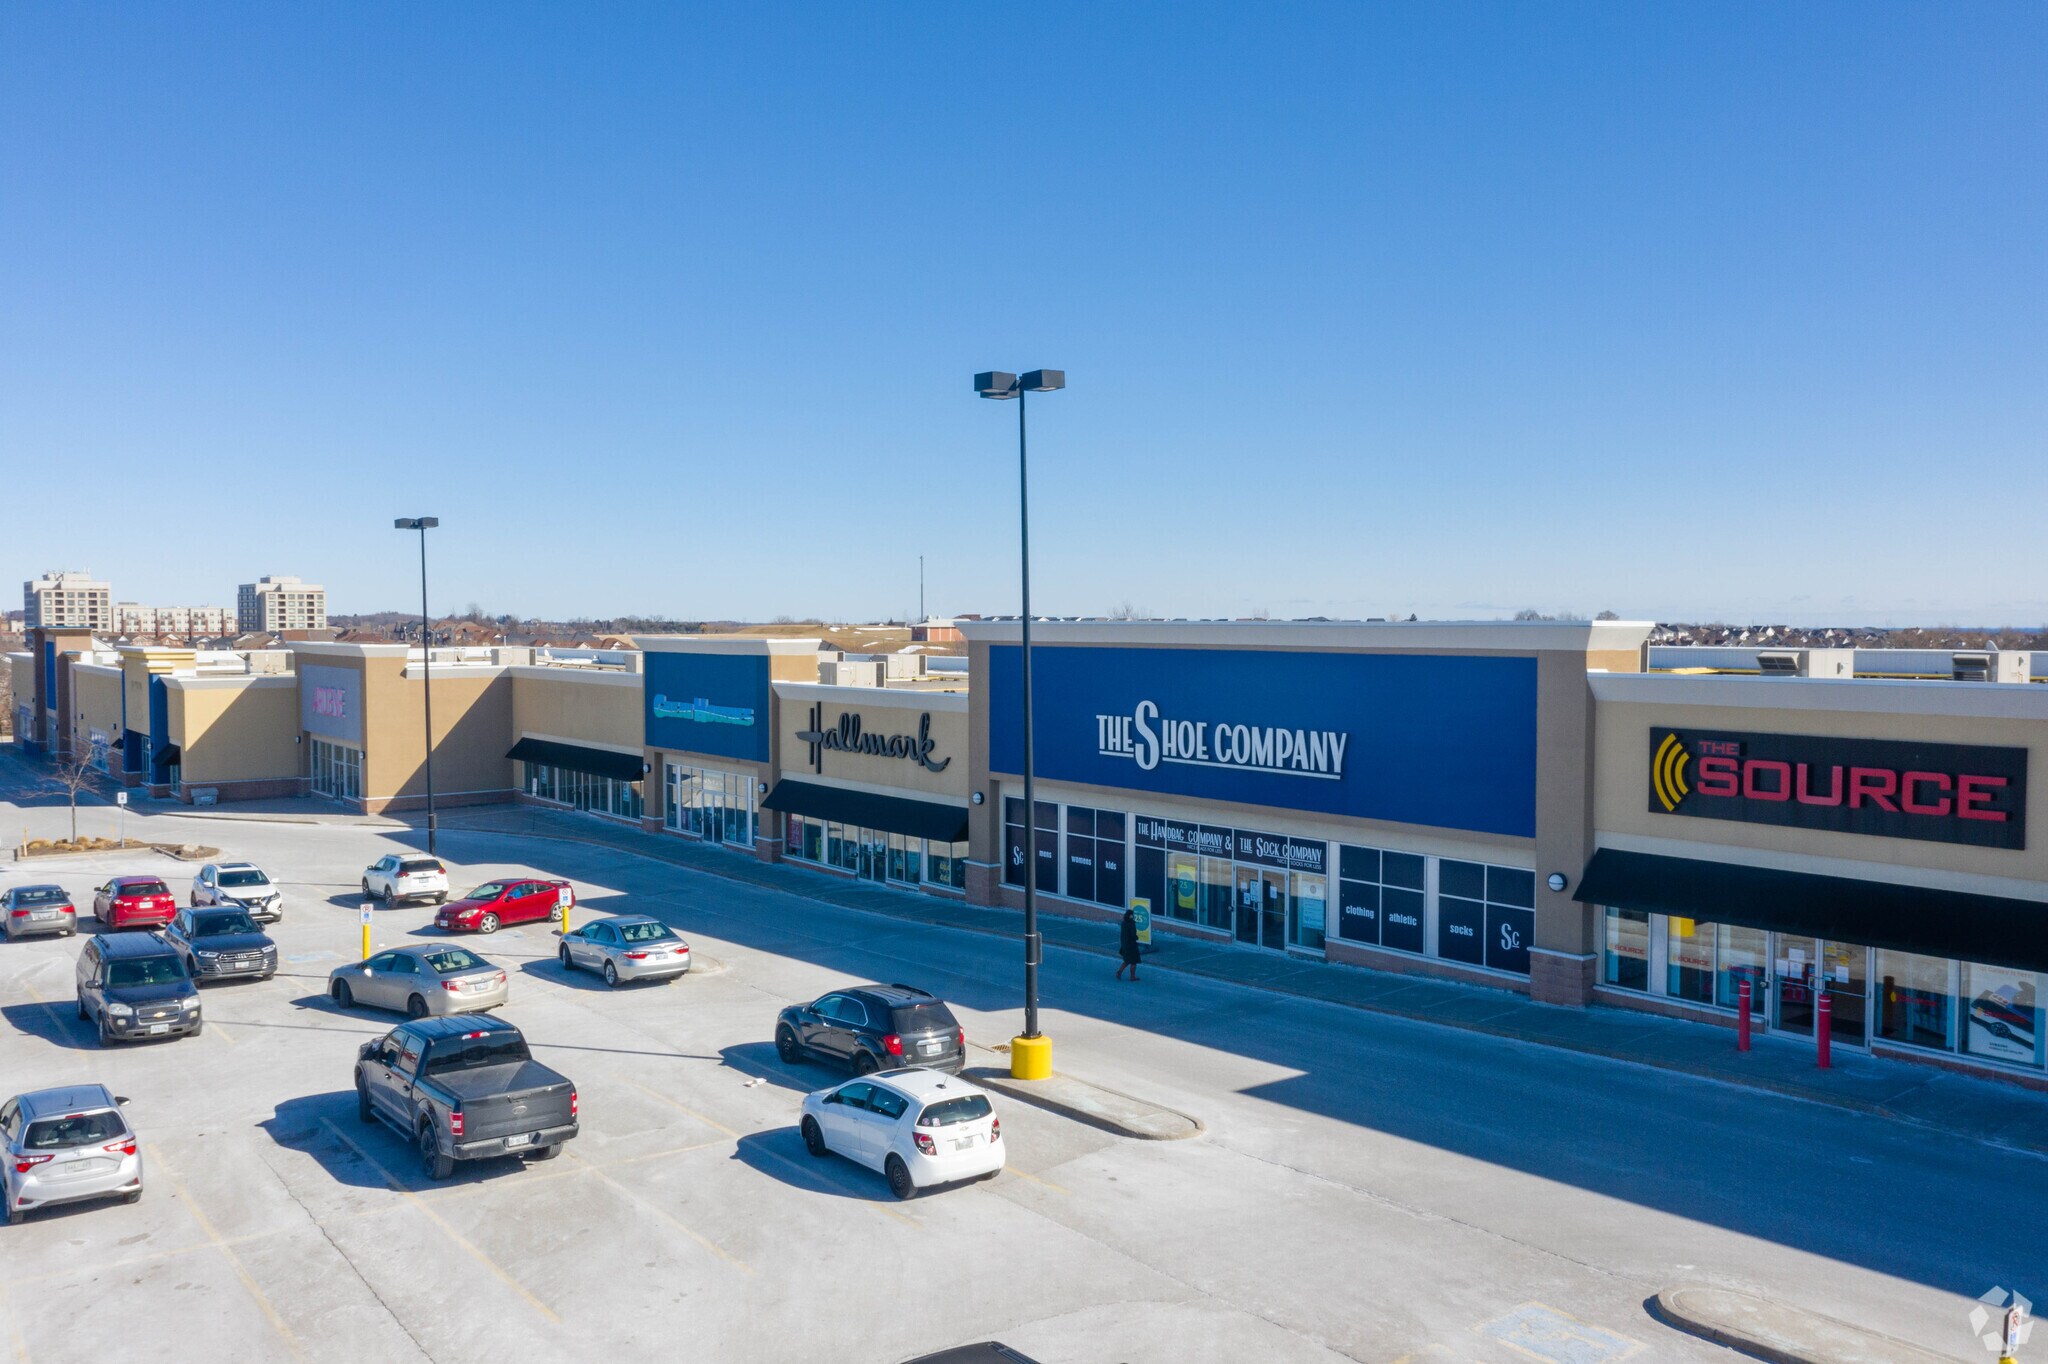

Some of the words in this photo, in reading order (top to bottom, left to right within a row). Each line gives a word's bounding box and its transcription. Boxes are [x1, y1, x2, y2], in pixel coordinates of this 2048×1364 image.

[795, 701, 951, 774] Hallmark
[1096, 715, 1134, 752] THE
[1135, 700, 1209, 770] SHOE
[1214, 723, 1347, 774] COMPANY
[1699, 741, 1740, 755] THE
[1697, 757, 2008, 822] SOURCE
[1137, 822, 1150, 836] THE
[1151, 821, 1185, 841] HANDBAG
[1188, 830, 1224, 847] COMPANY
[1224, 835, 1233, 851] &
[1239, 837, 1253, 852] THE
[1256, 837, 1281, 858] SOCK
[1282, 844, 1322, 862] COMPANY
[1071, 855, 1092, 866] womens
[1105, 860, 1117, 870] kids
[1345, 905, 1375, 920] clothing
[1388, 912, 1417, 926] athletic
[1450, 923, 1474, 937] socks
